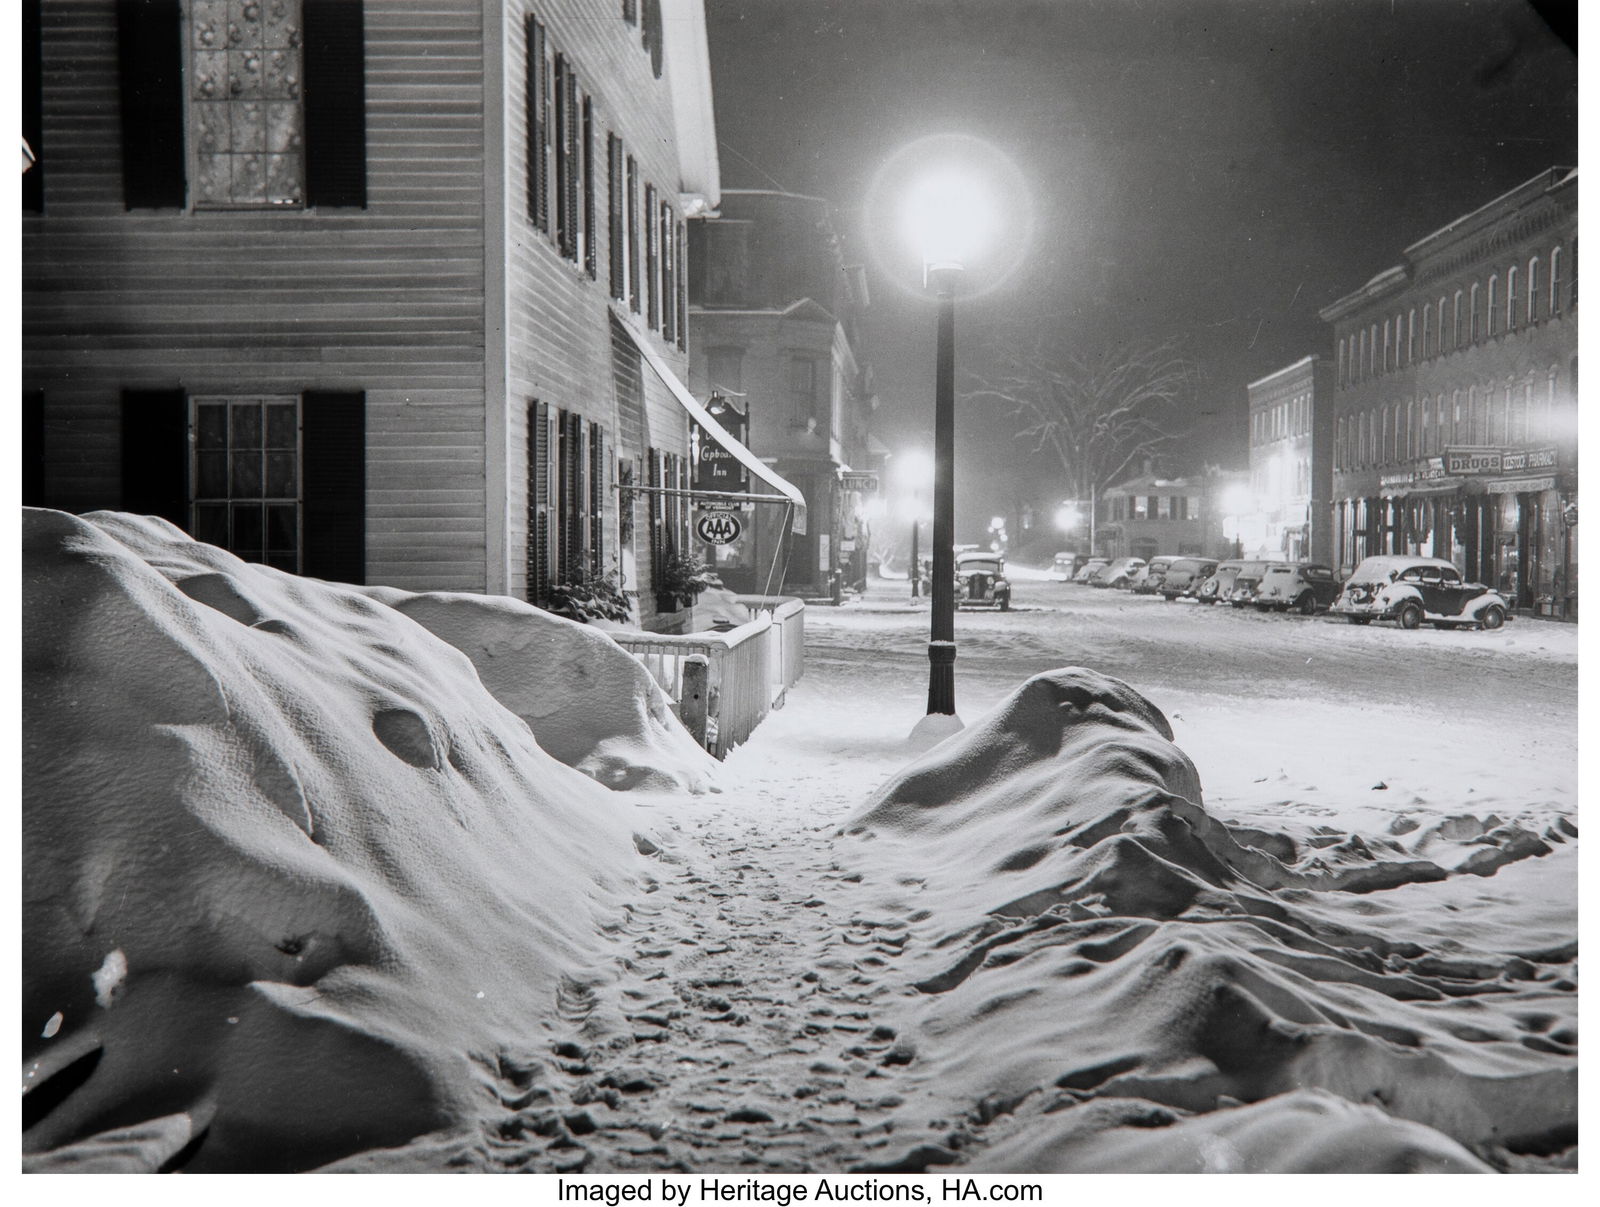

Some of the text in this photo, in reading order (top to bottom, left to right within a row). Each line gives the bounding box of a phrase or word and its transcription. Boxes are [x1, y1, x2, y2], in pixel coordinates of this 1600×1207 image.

[701, 445, 732, 461] Cupboa
[713, 463, 727, 476] Inn
[1451, 456, 1499, 470] DRUGS
[843, 480, 877, 488] LUNCH
[705, 512, 732, 521] OFFICIAL
[706, 519, 731, 538] AAA
